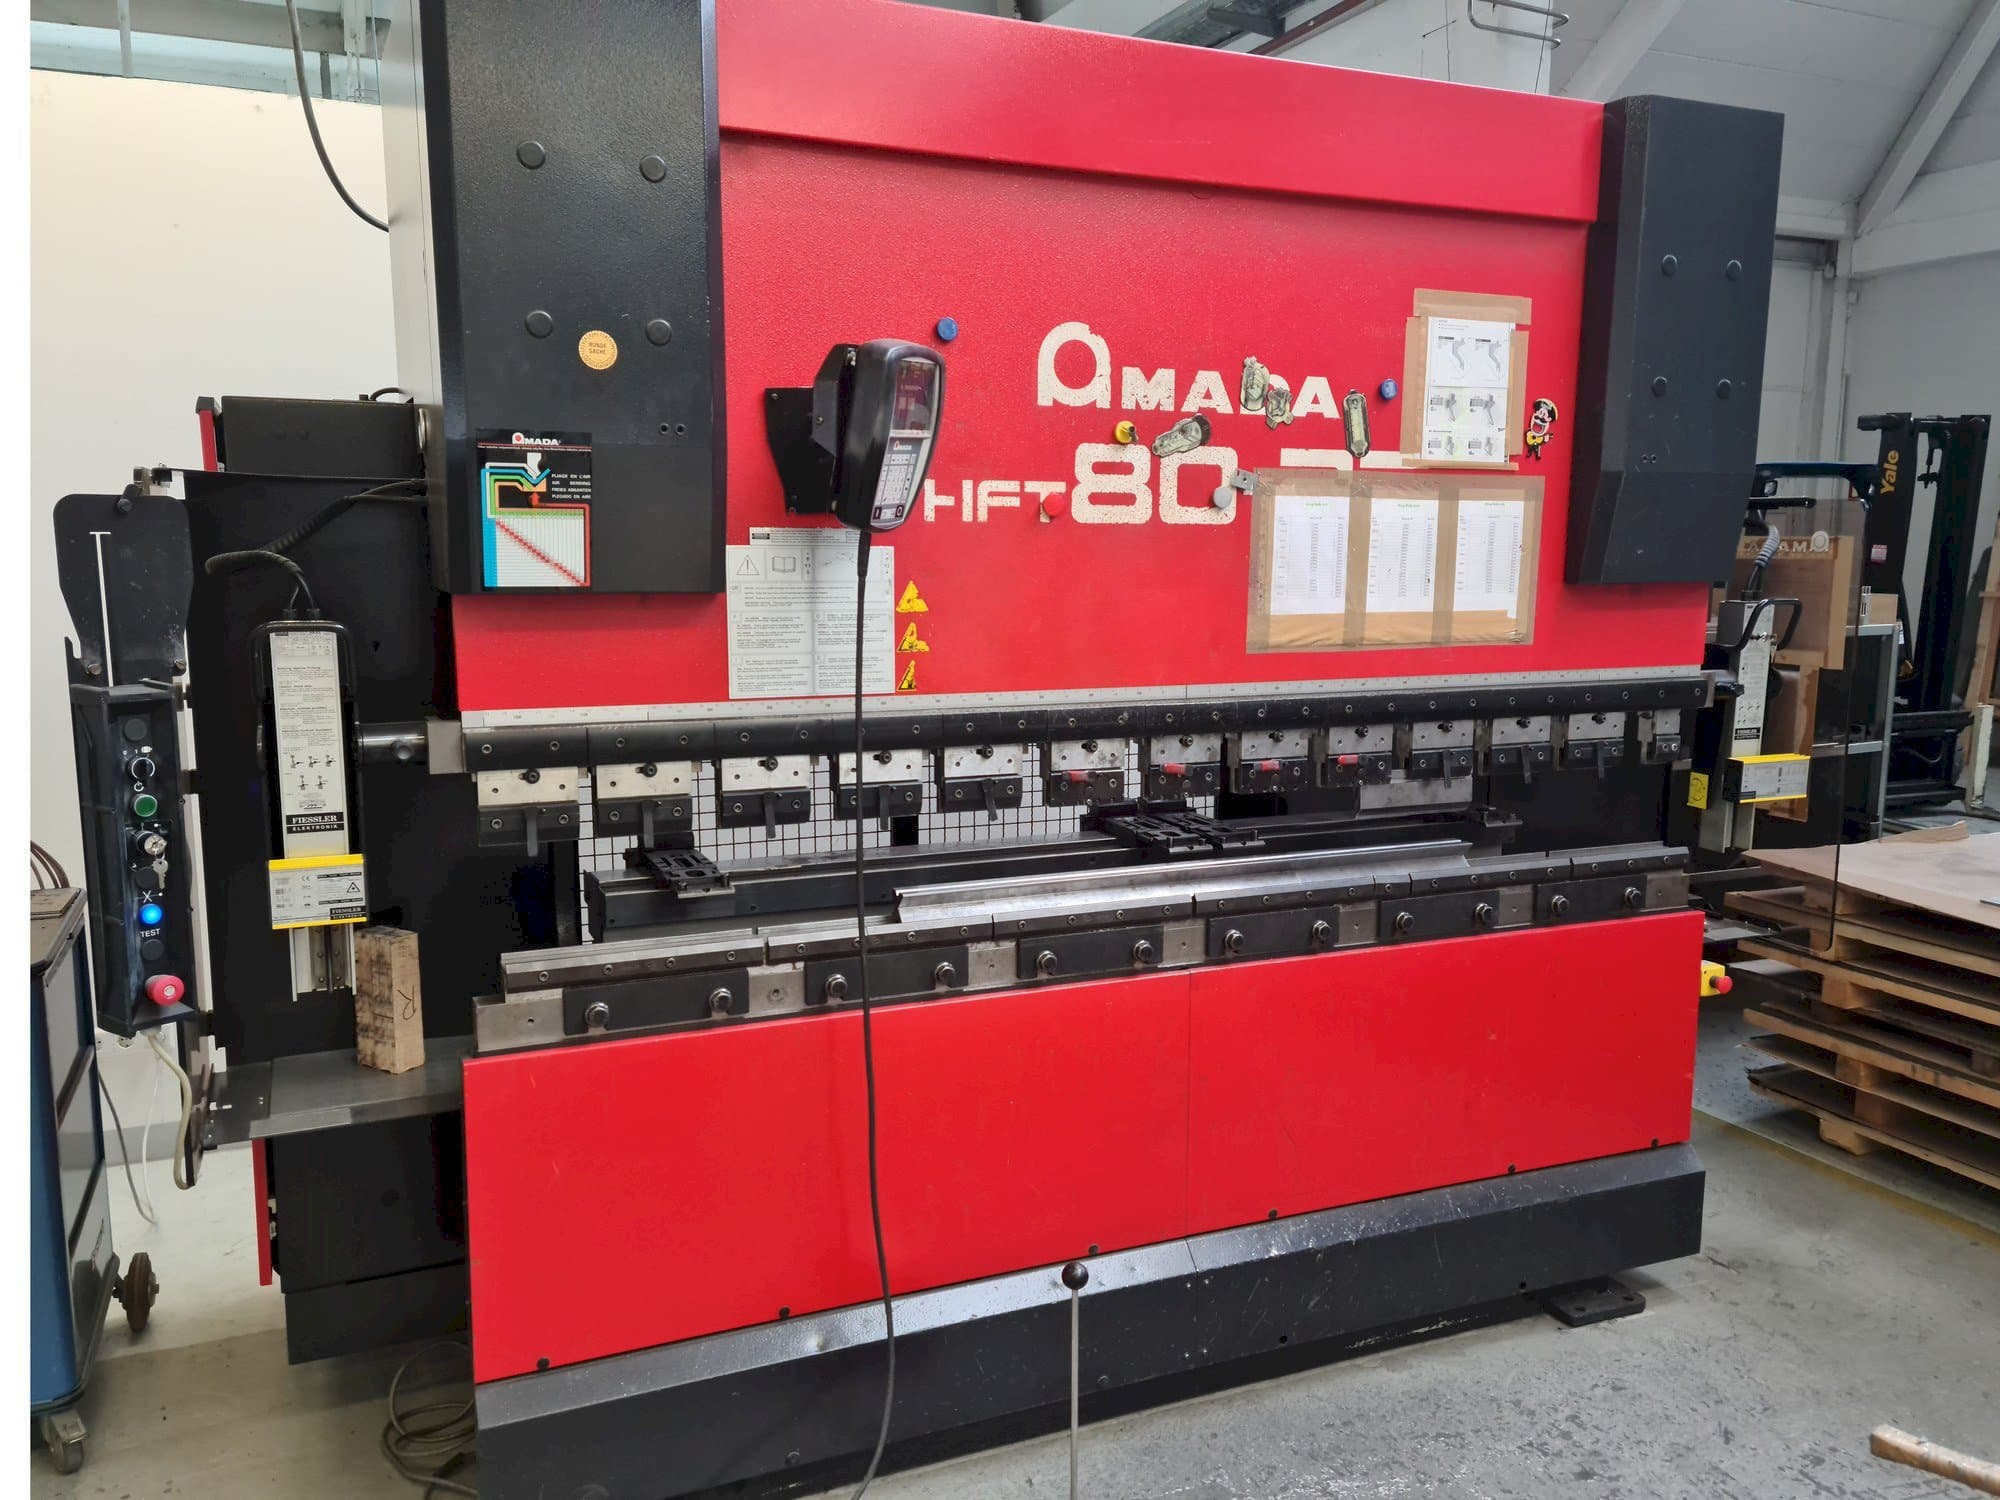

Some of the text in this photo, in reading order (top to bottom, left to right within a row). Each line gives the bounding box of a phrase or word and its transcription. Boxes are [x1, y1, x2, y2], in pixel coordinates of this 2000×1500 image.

[511, 432, 559, 445] AMADA
[1880, 450, 1899, 494] Yale
[1071, 442, 1238, 525] 80
[291, 815, 338, 824] FIESSLER
[292, 824, 338, 832] ELEKTRONIK
[140, 928, 161, 938] TEST
